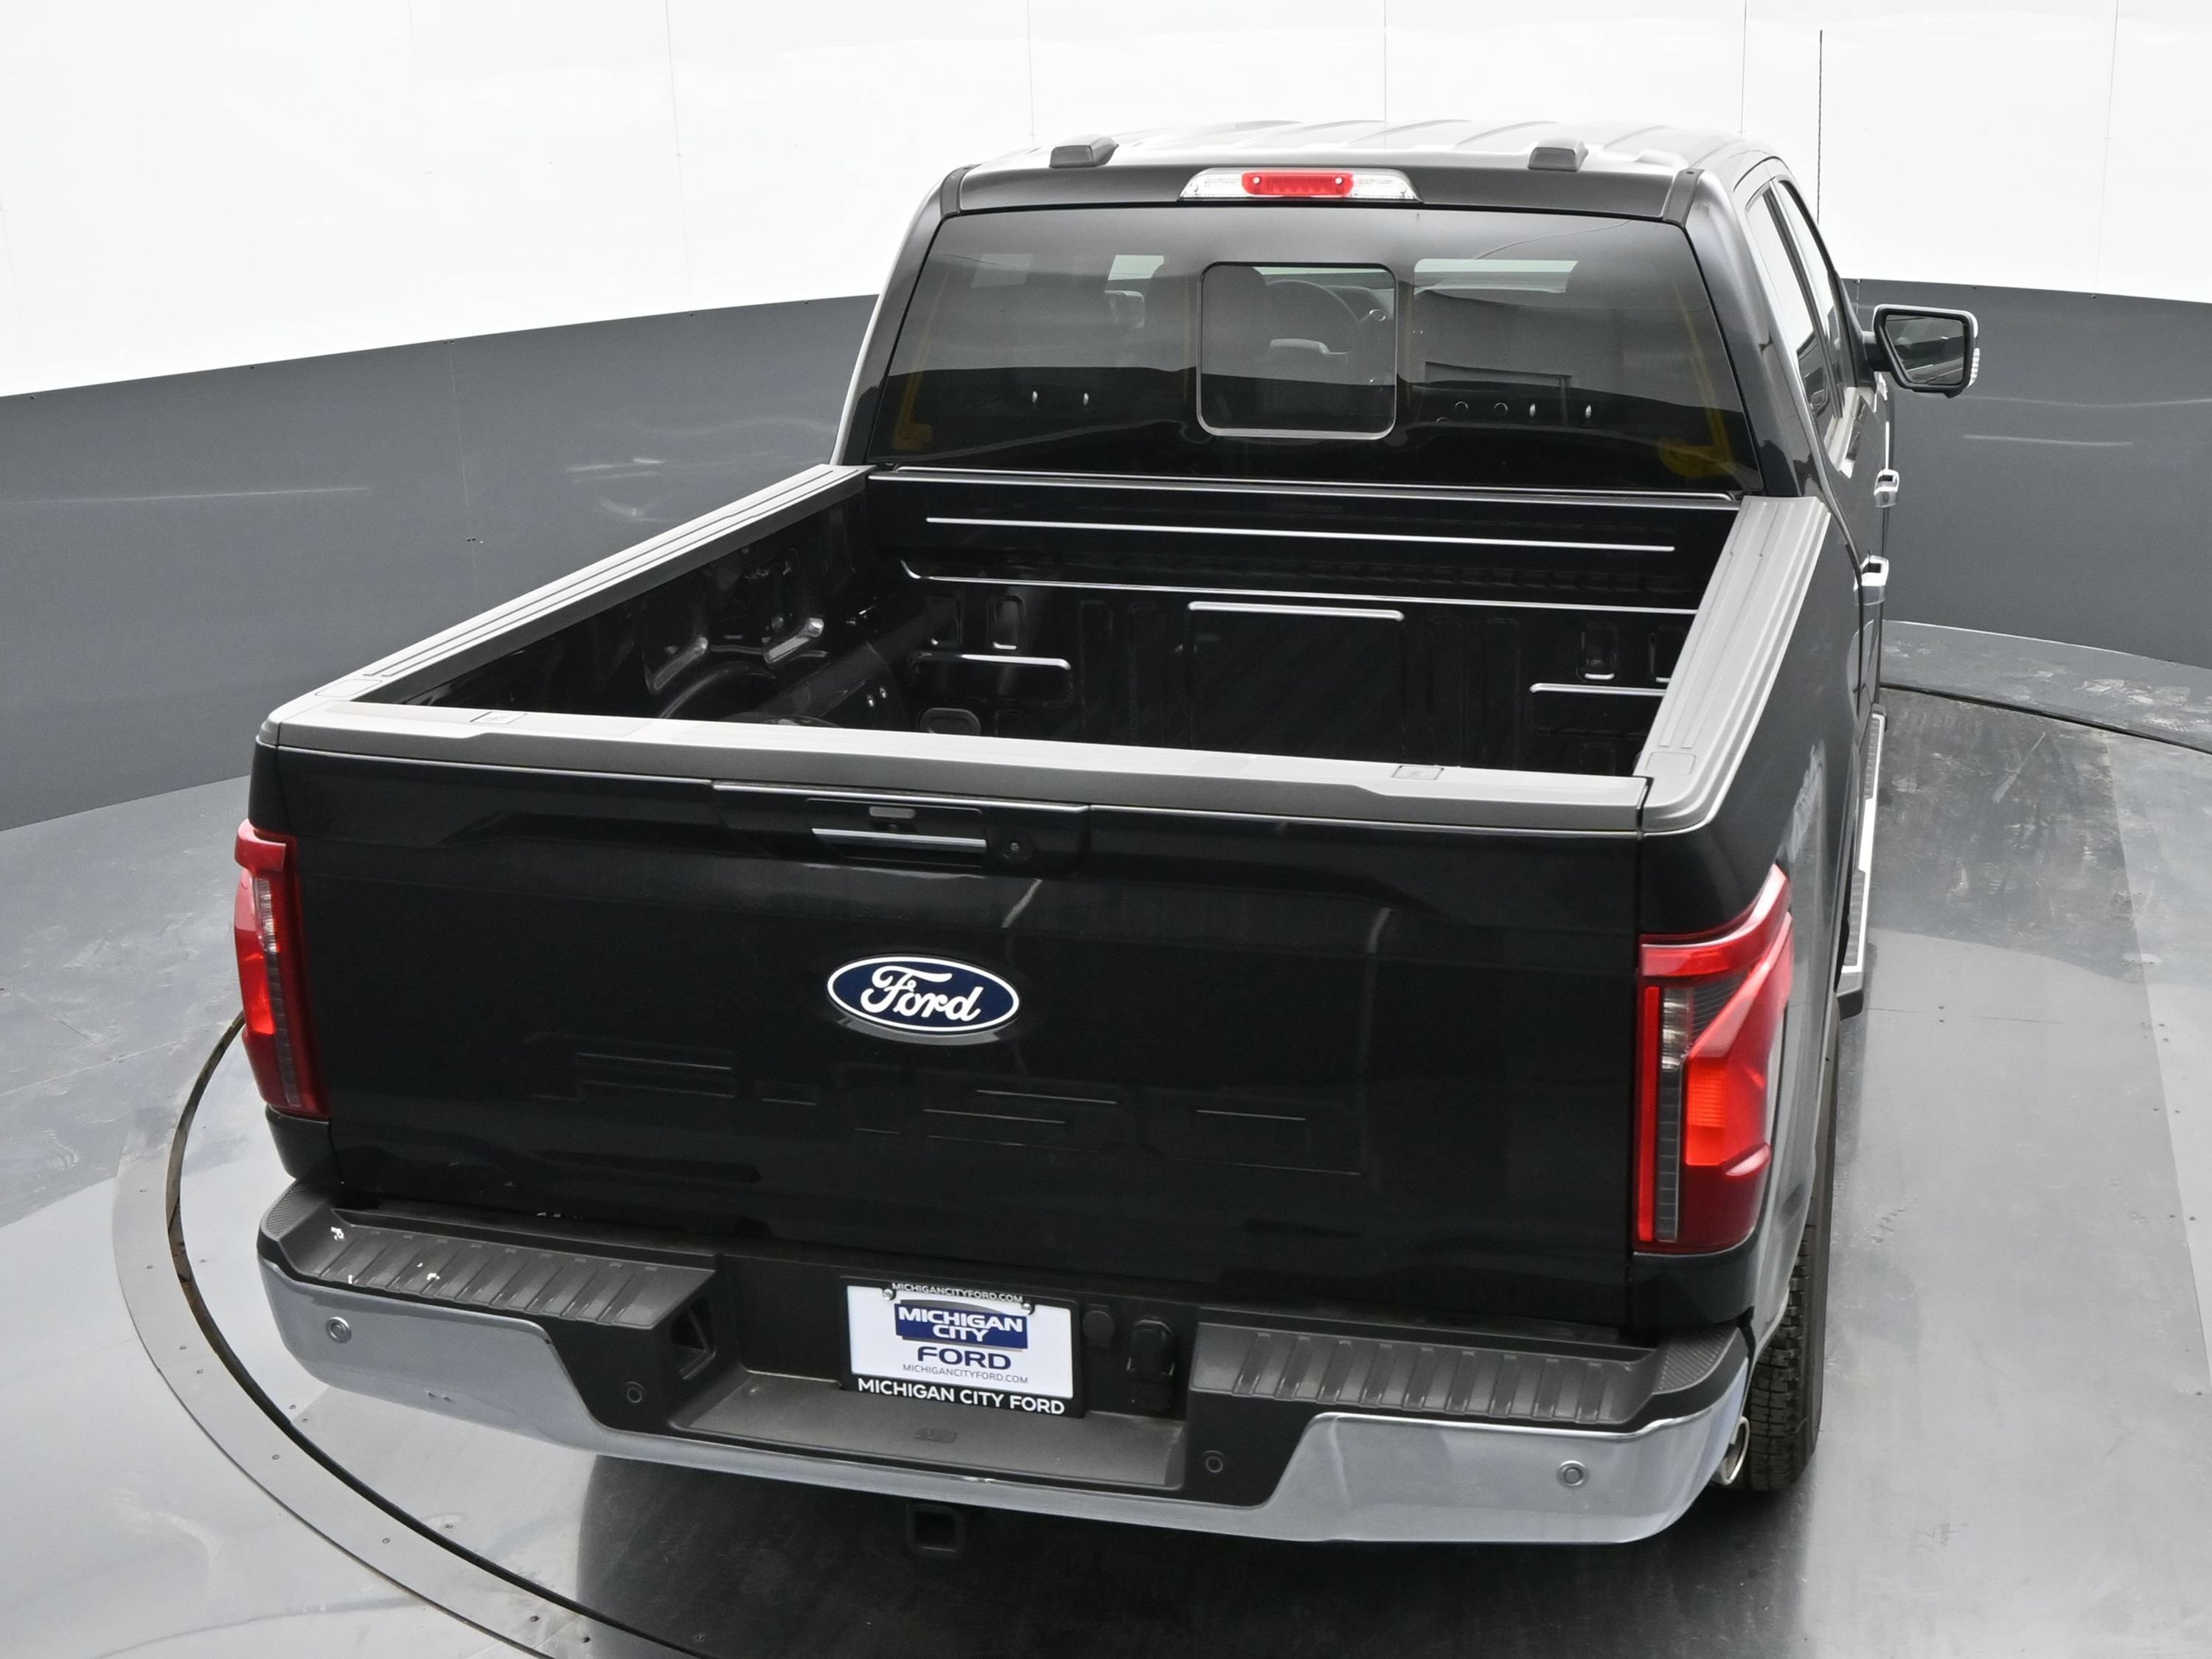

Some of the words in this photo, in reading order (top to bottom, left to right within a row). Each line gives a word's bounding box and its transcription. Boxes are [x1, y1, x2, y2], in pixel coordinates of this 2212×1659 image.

[860, 965, 984, 1021] Ford
[891, 1282, 1023, 1303] MICHIGANCITYFORD.COM
[899, 1307, 1023, 1332] MICHIGAN
[933, 1325, 989, 1342] CITY
[918, 1346, 1011, 1370] FORD
[902, 1364, 1029, 1384] MICHIGANCITYFORD.COM
[858, 1378, 954, 1402] MICHIGAN
[960, 1390, 1004, 1408] CITY
[1010, 1396, 1065, 1416] FORD
